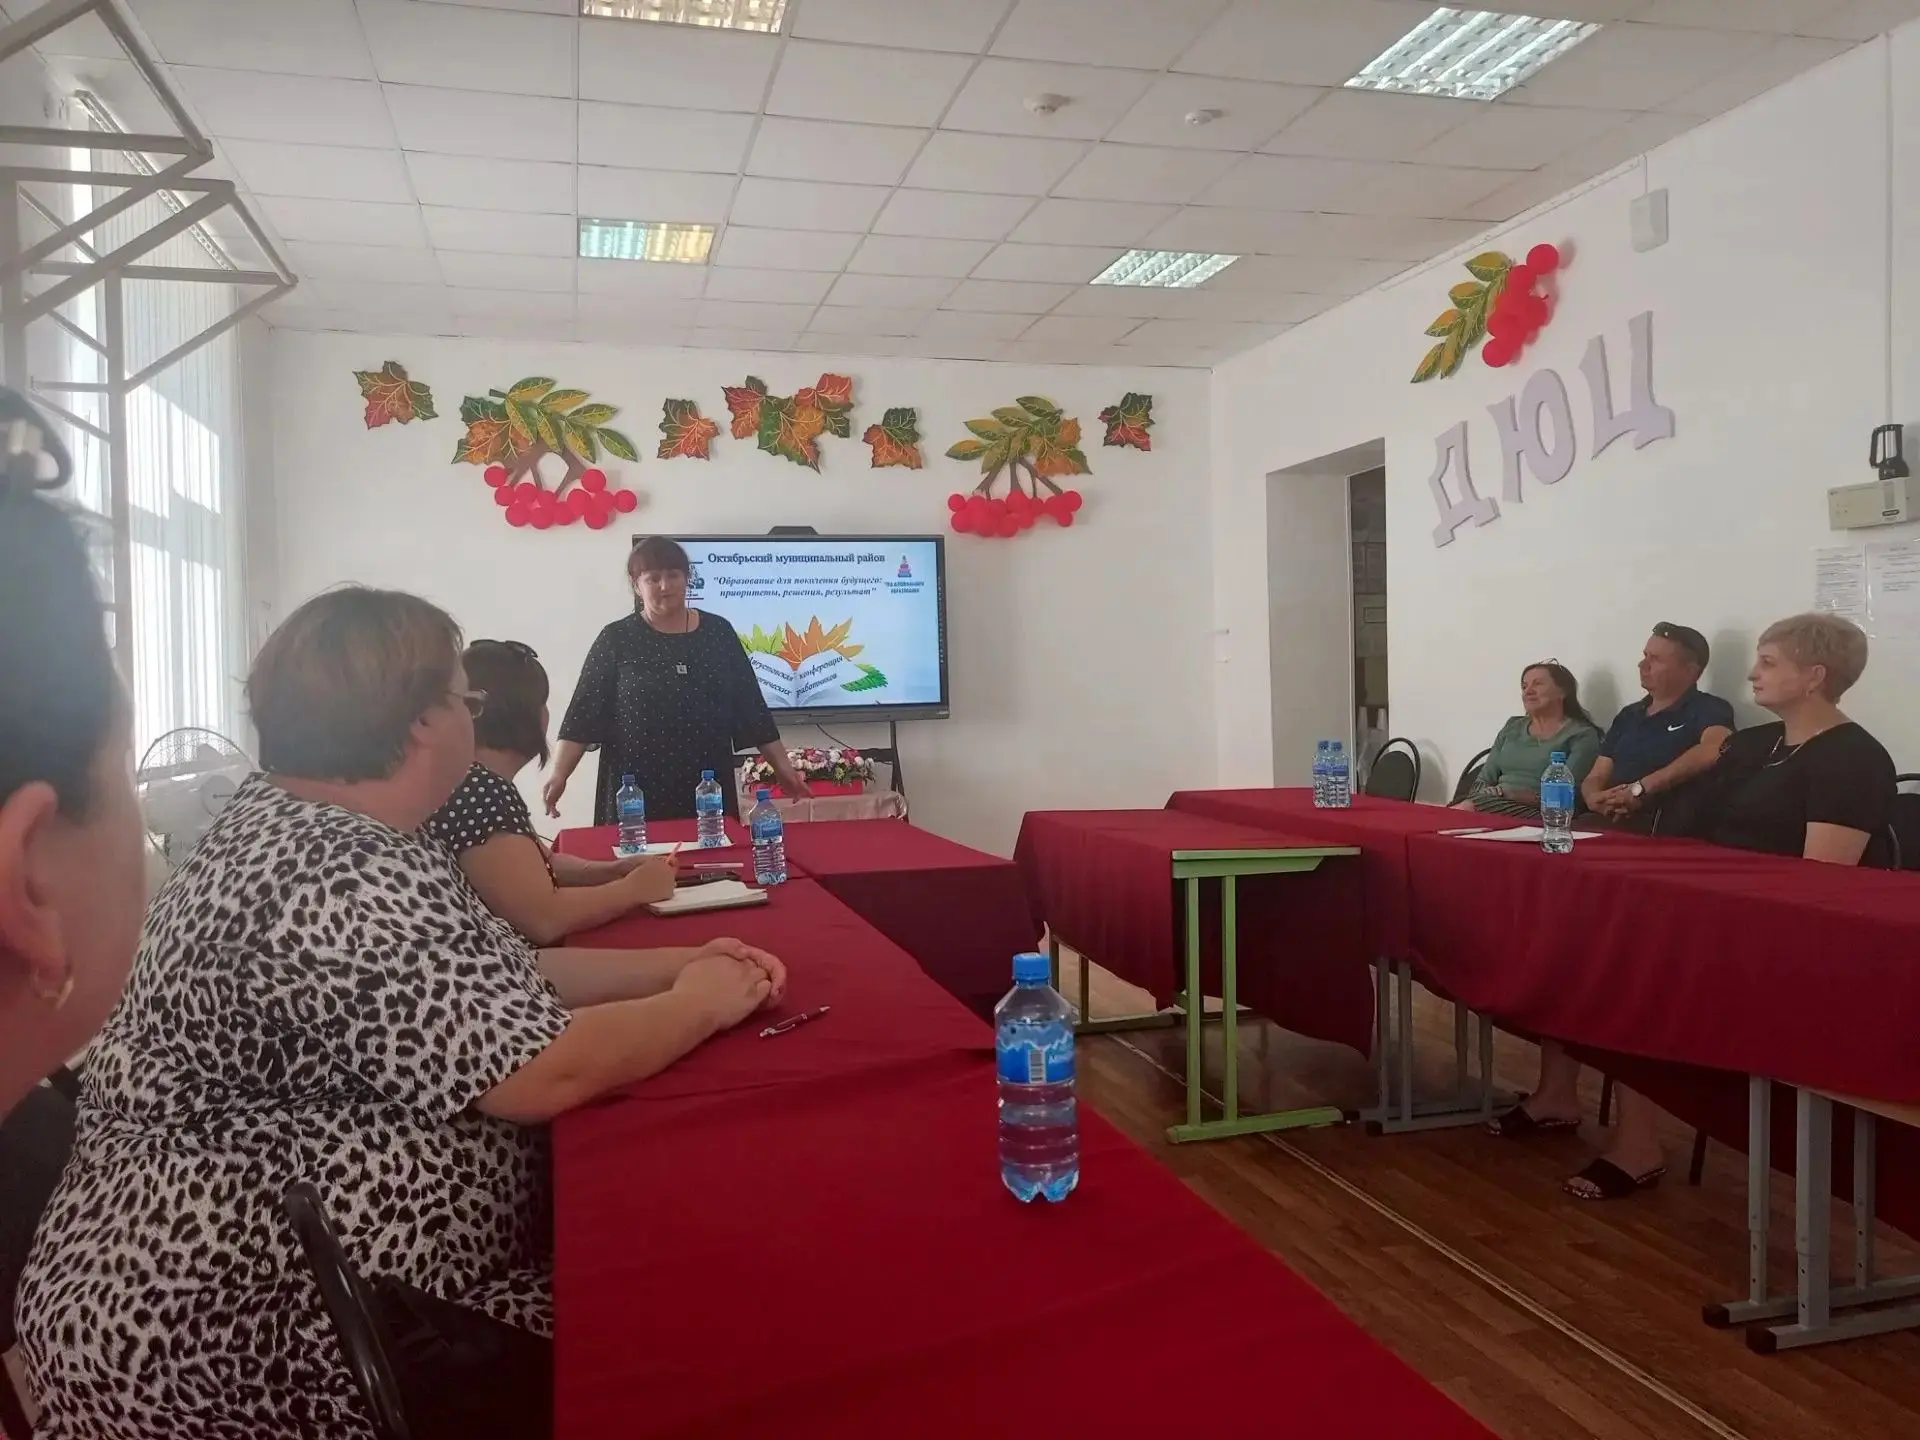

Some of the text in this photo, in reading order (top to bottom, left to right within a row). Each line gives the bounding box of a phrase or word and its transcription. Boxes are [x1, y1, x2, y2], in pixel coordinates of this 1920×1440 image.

[1428, 310, 1676, 548] ДЮЦ
[707, 552, 885, 565] Октябрьский муниципальный район
[776, 576, 792, 585] для
[782, 588, 823, 598] решения,
[799, 655, 843, 680] конференция
